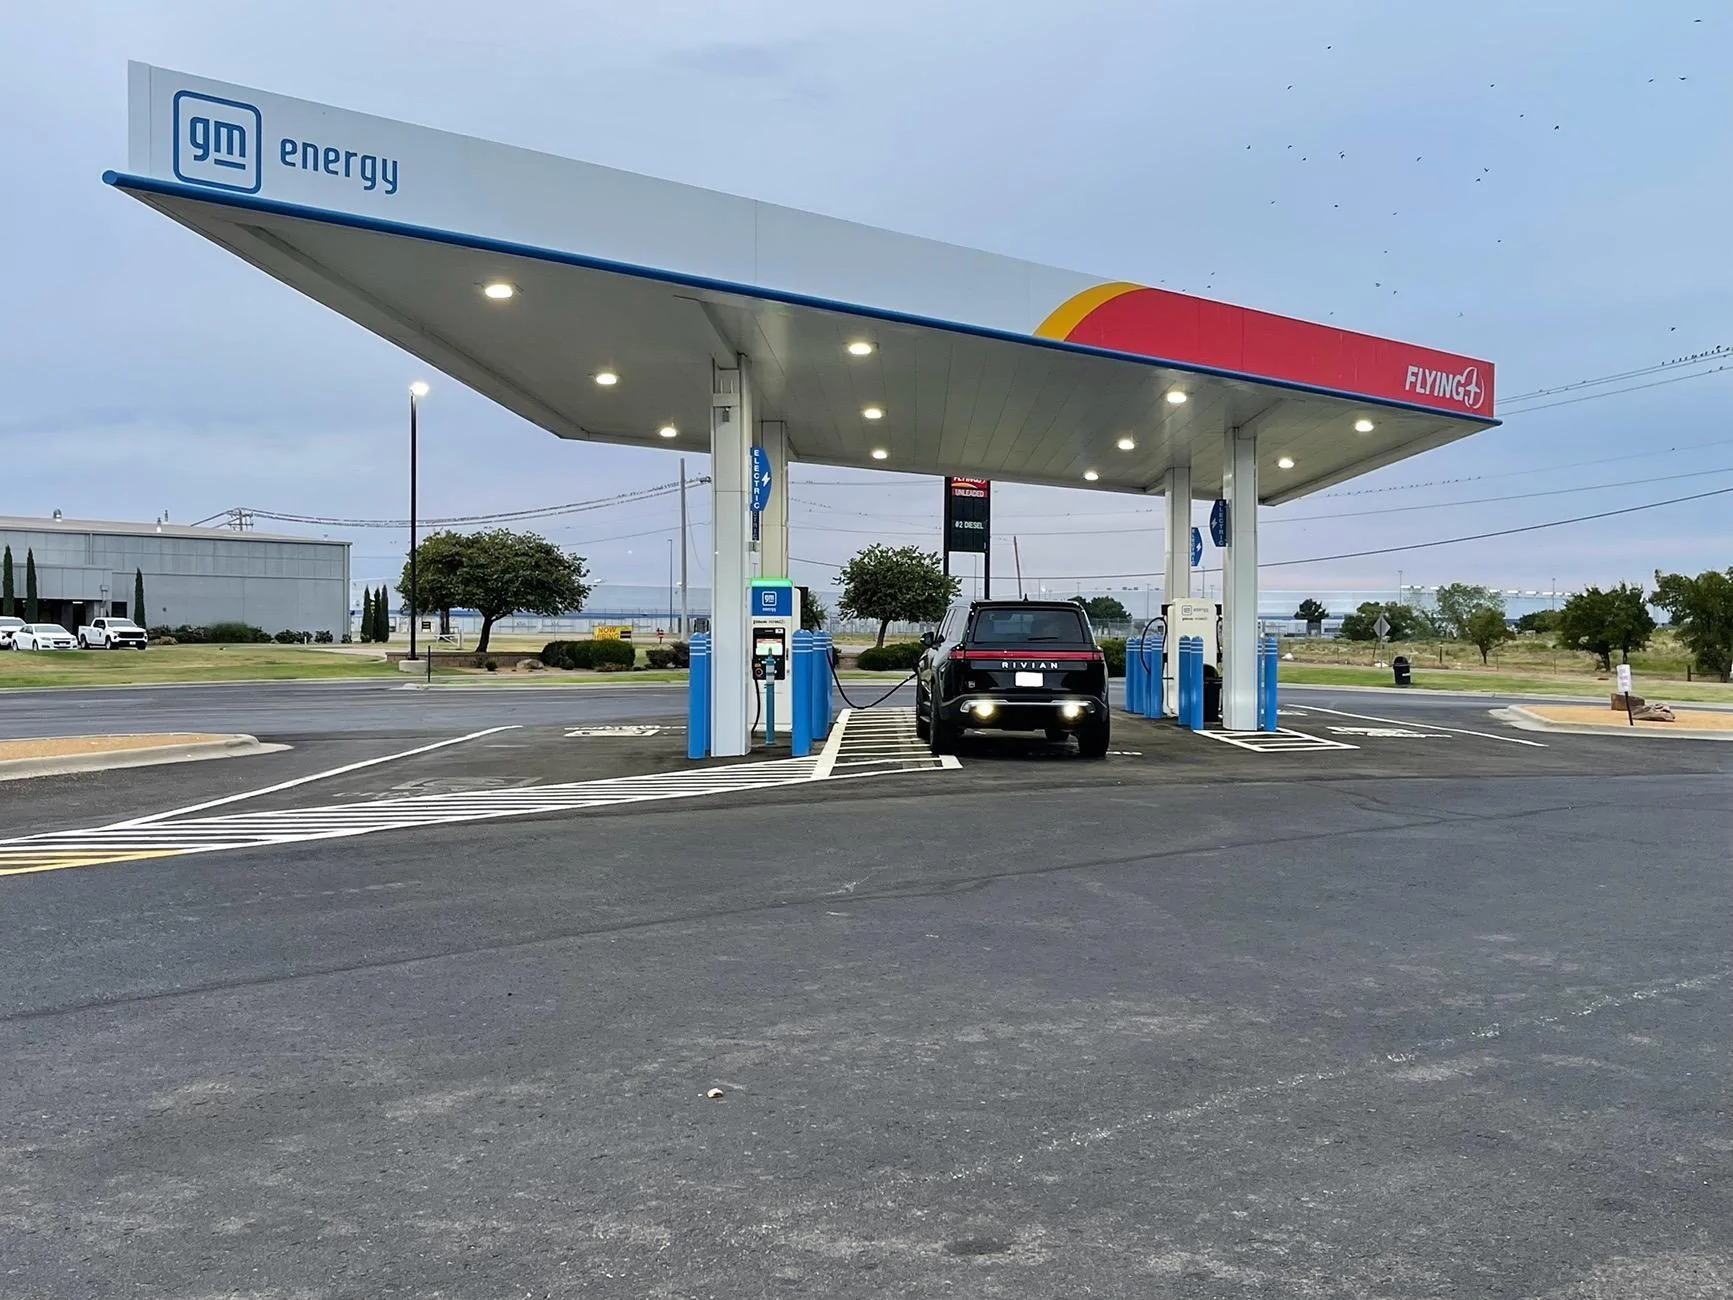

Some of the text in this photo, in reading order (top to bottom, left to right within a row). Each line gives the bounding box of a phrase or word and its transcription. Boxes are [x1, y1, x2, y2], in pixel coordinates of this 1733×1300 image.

[189, 116, 398, 195] gm energy
[954, 488, 985, 498] UNLEADED
[964, 521, 984, 530] DIESEL
[1001, 661, 1059, 669] RIVIAN
